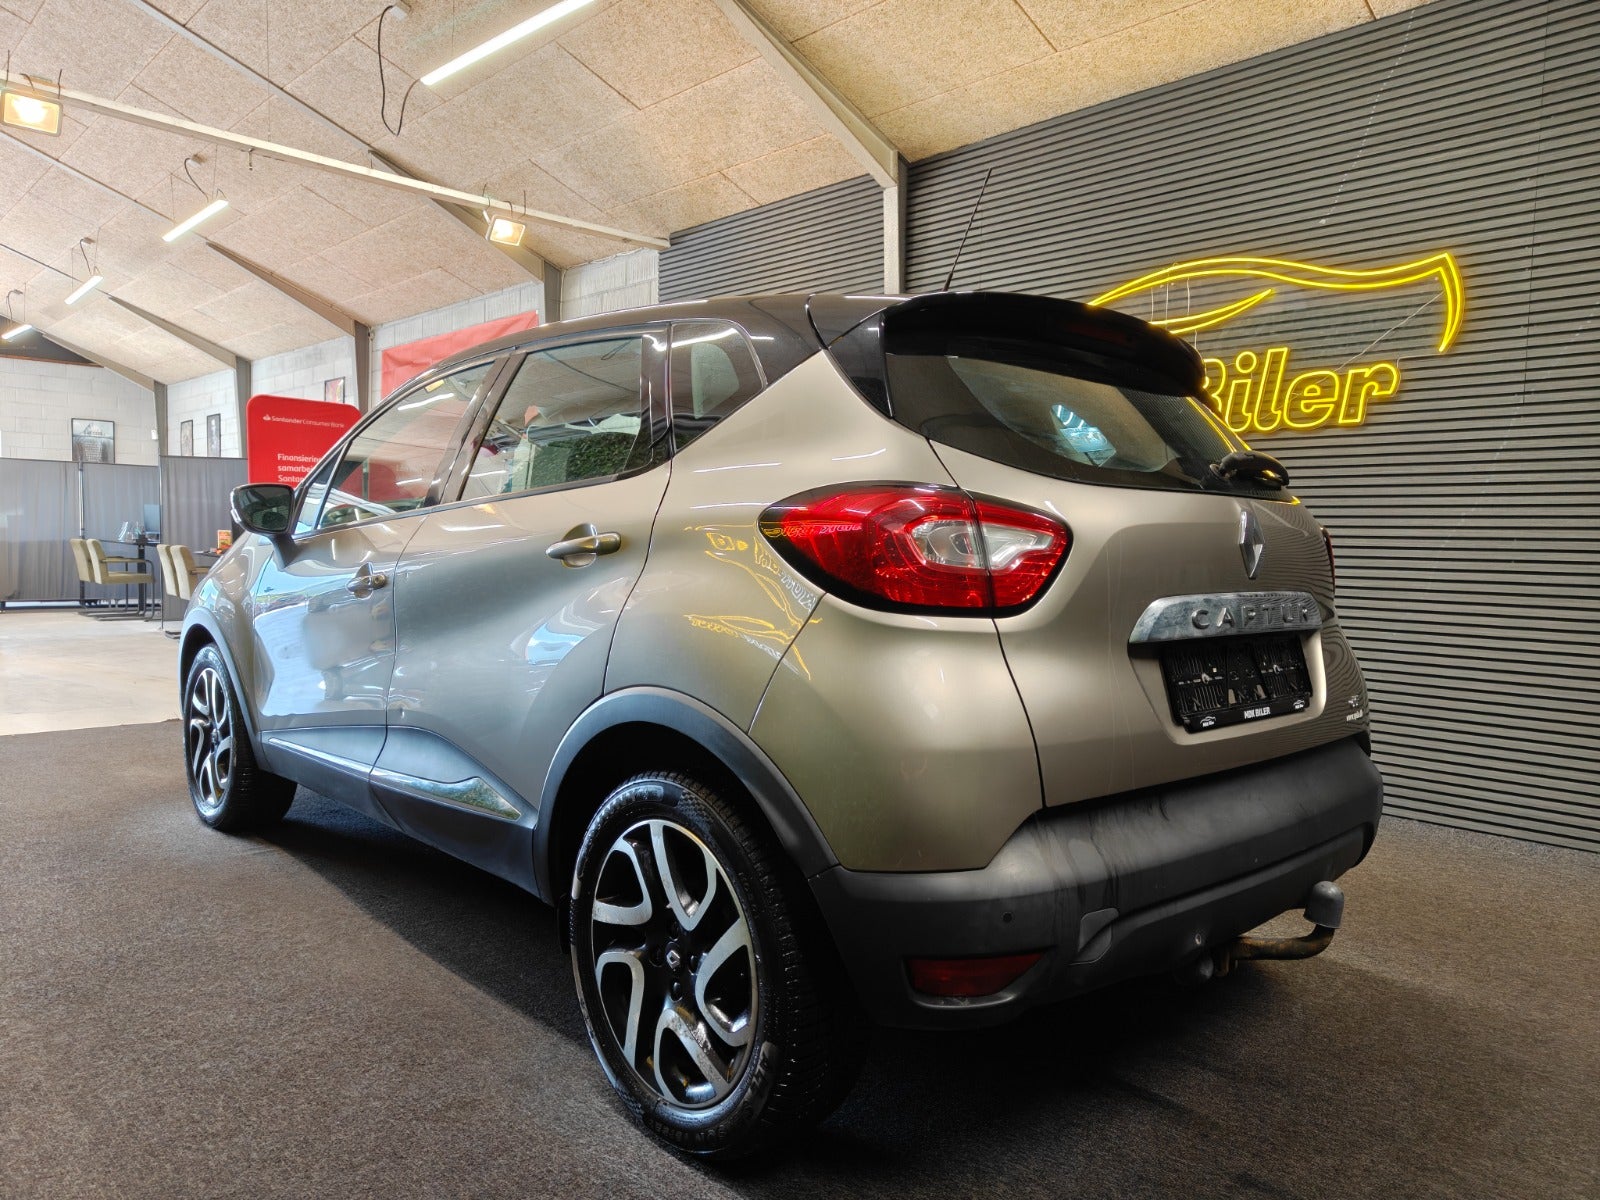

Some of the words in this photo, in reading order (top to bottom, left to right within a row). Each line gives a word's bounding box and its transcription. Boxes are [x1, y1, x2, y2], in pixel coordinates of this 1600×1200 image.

[271, 416, 302, 424] Santander
[303, 419, 330, 427] Consumer
[277, 453, 321, 463] Finansierin
[277, 465, 314, 473] samarbe
[1191, 603, 1310, 630] CAPTUR
[1255, 707, 1271, 717] BILER
